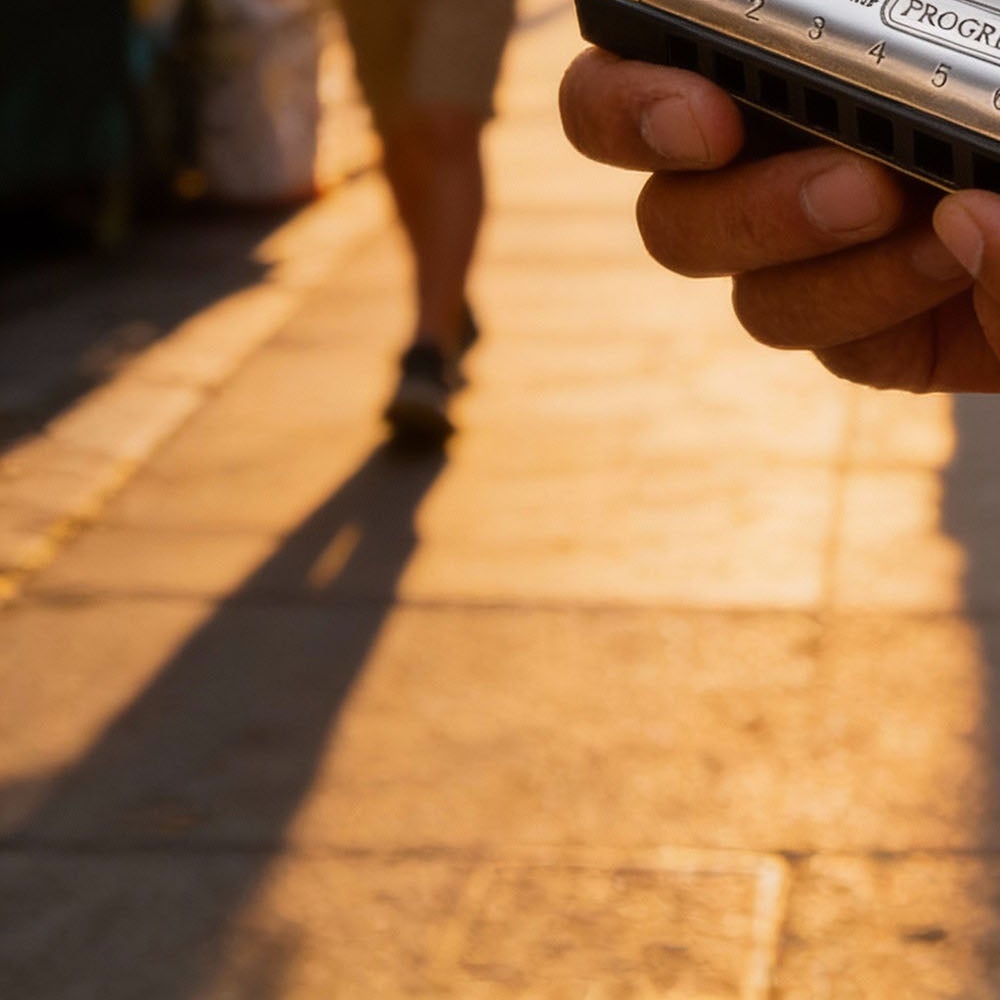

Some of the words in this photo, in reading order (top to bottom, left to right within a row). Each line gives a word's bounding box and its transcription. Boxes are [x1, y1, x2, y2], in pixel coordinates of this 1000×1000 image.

[808, 16, 826, 40] 3
[868, 40, 886, 64] 4
[931, 63, 952, 88] 5
